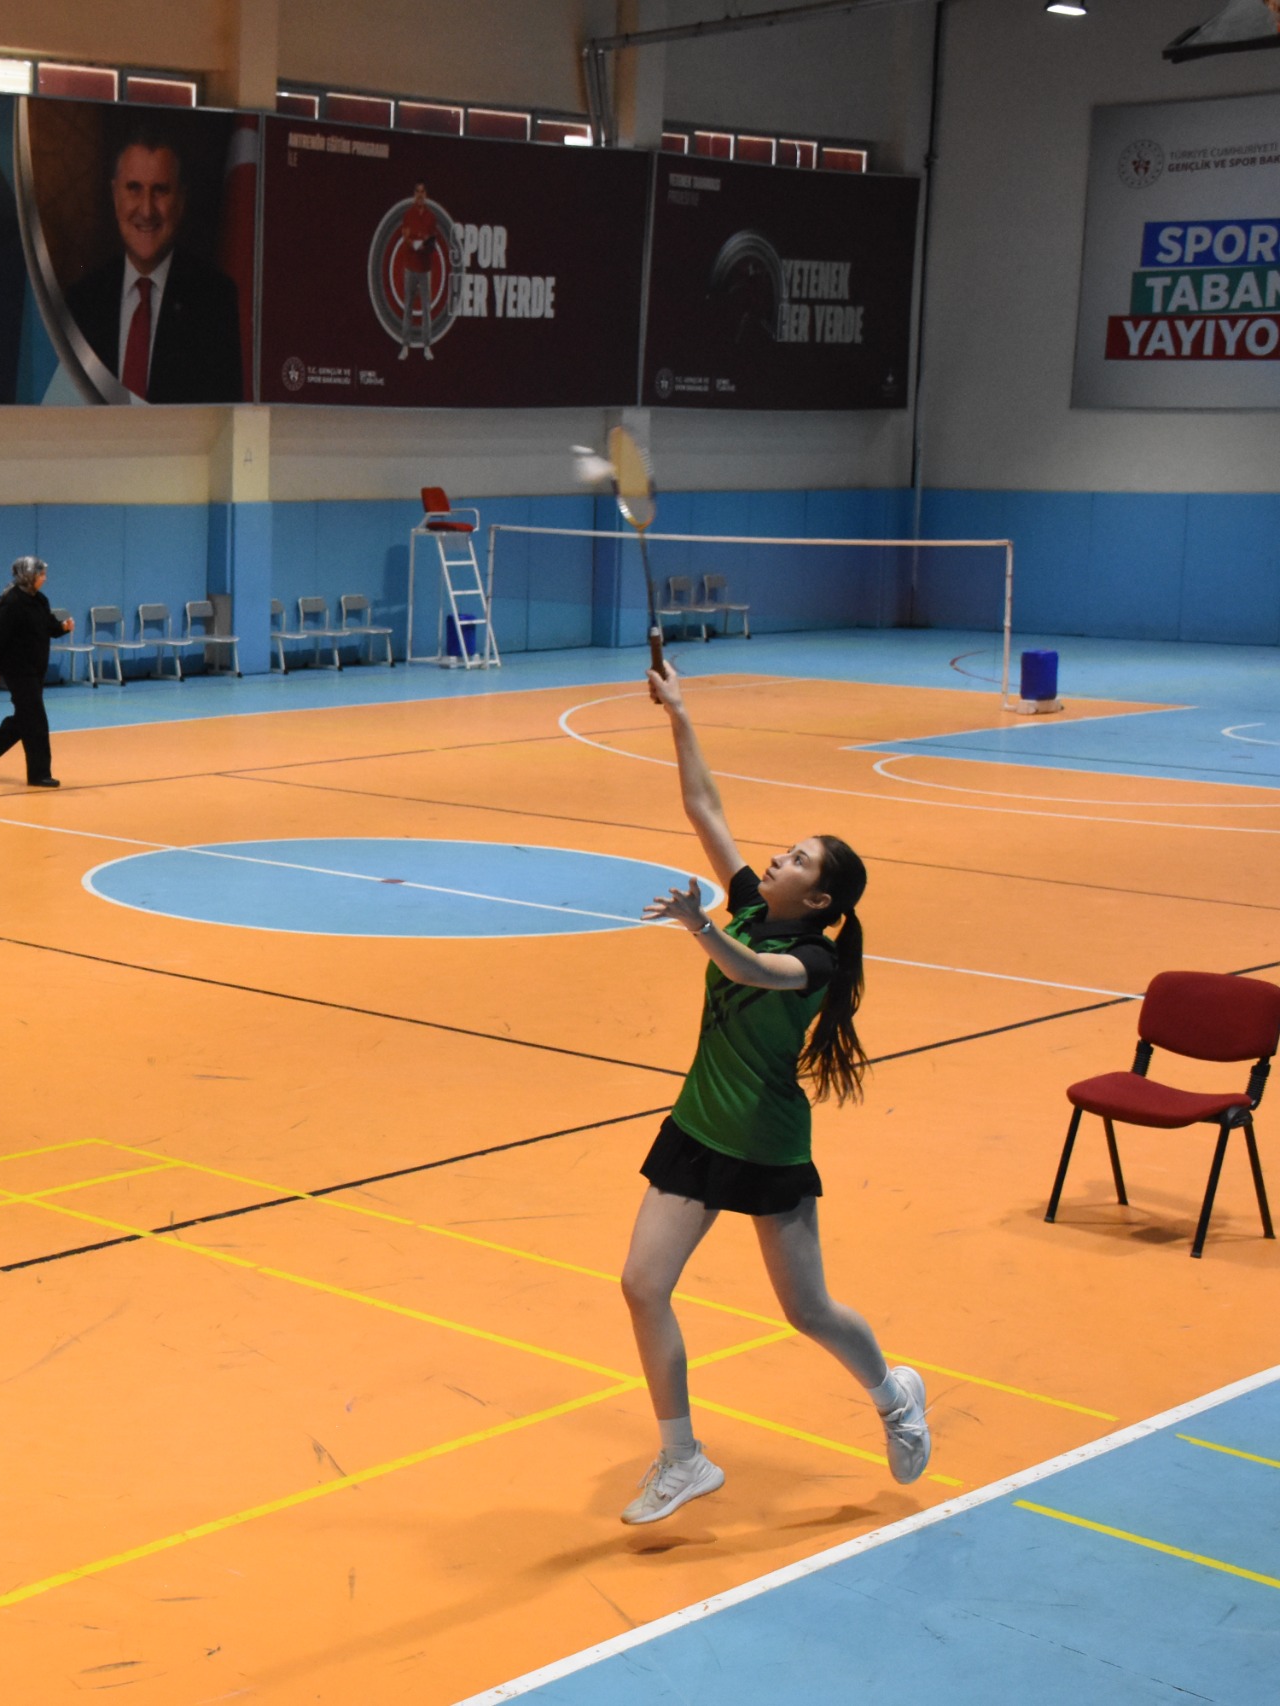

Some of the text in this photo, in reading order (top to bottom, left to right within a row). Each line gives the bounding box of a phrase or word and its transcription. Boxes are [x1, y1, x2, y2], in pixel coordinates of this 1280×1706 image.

[1168, 159, 1210, 173] GENÇLİK
[1213, 159, 1226, 168] VE
[1229, 156, 1257, 168] SPOR
[449, 222, 508, 269] SPOR
[448, 273, 556, 318] HER YERDE
[780, 259, 852, 299] YETENEK
[777, 303, 864, 344] HER YERDE
